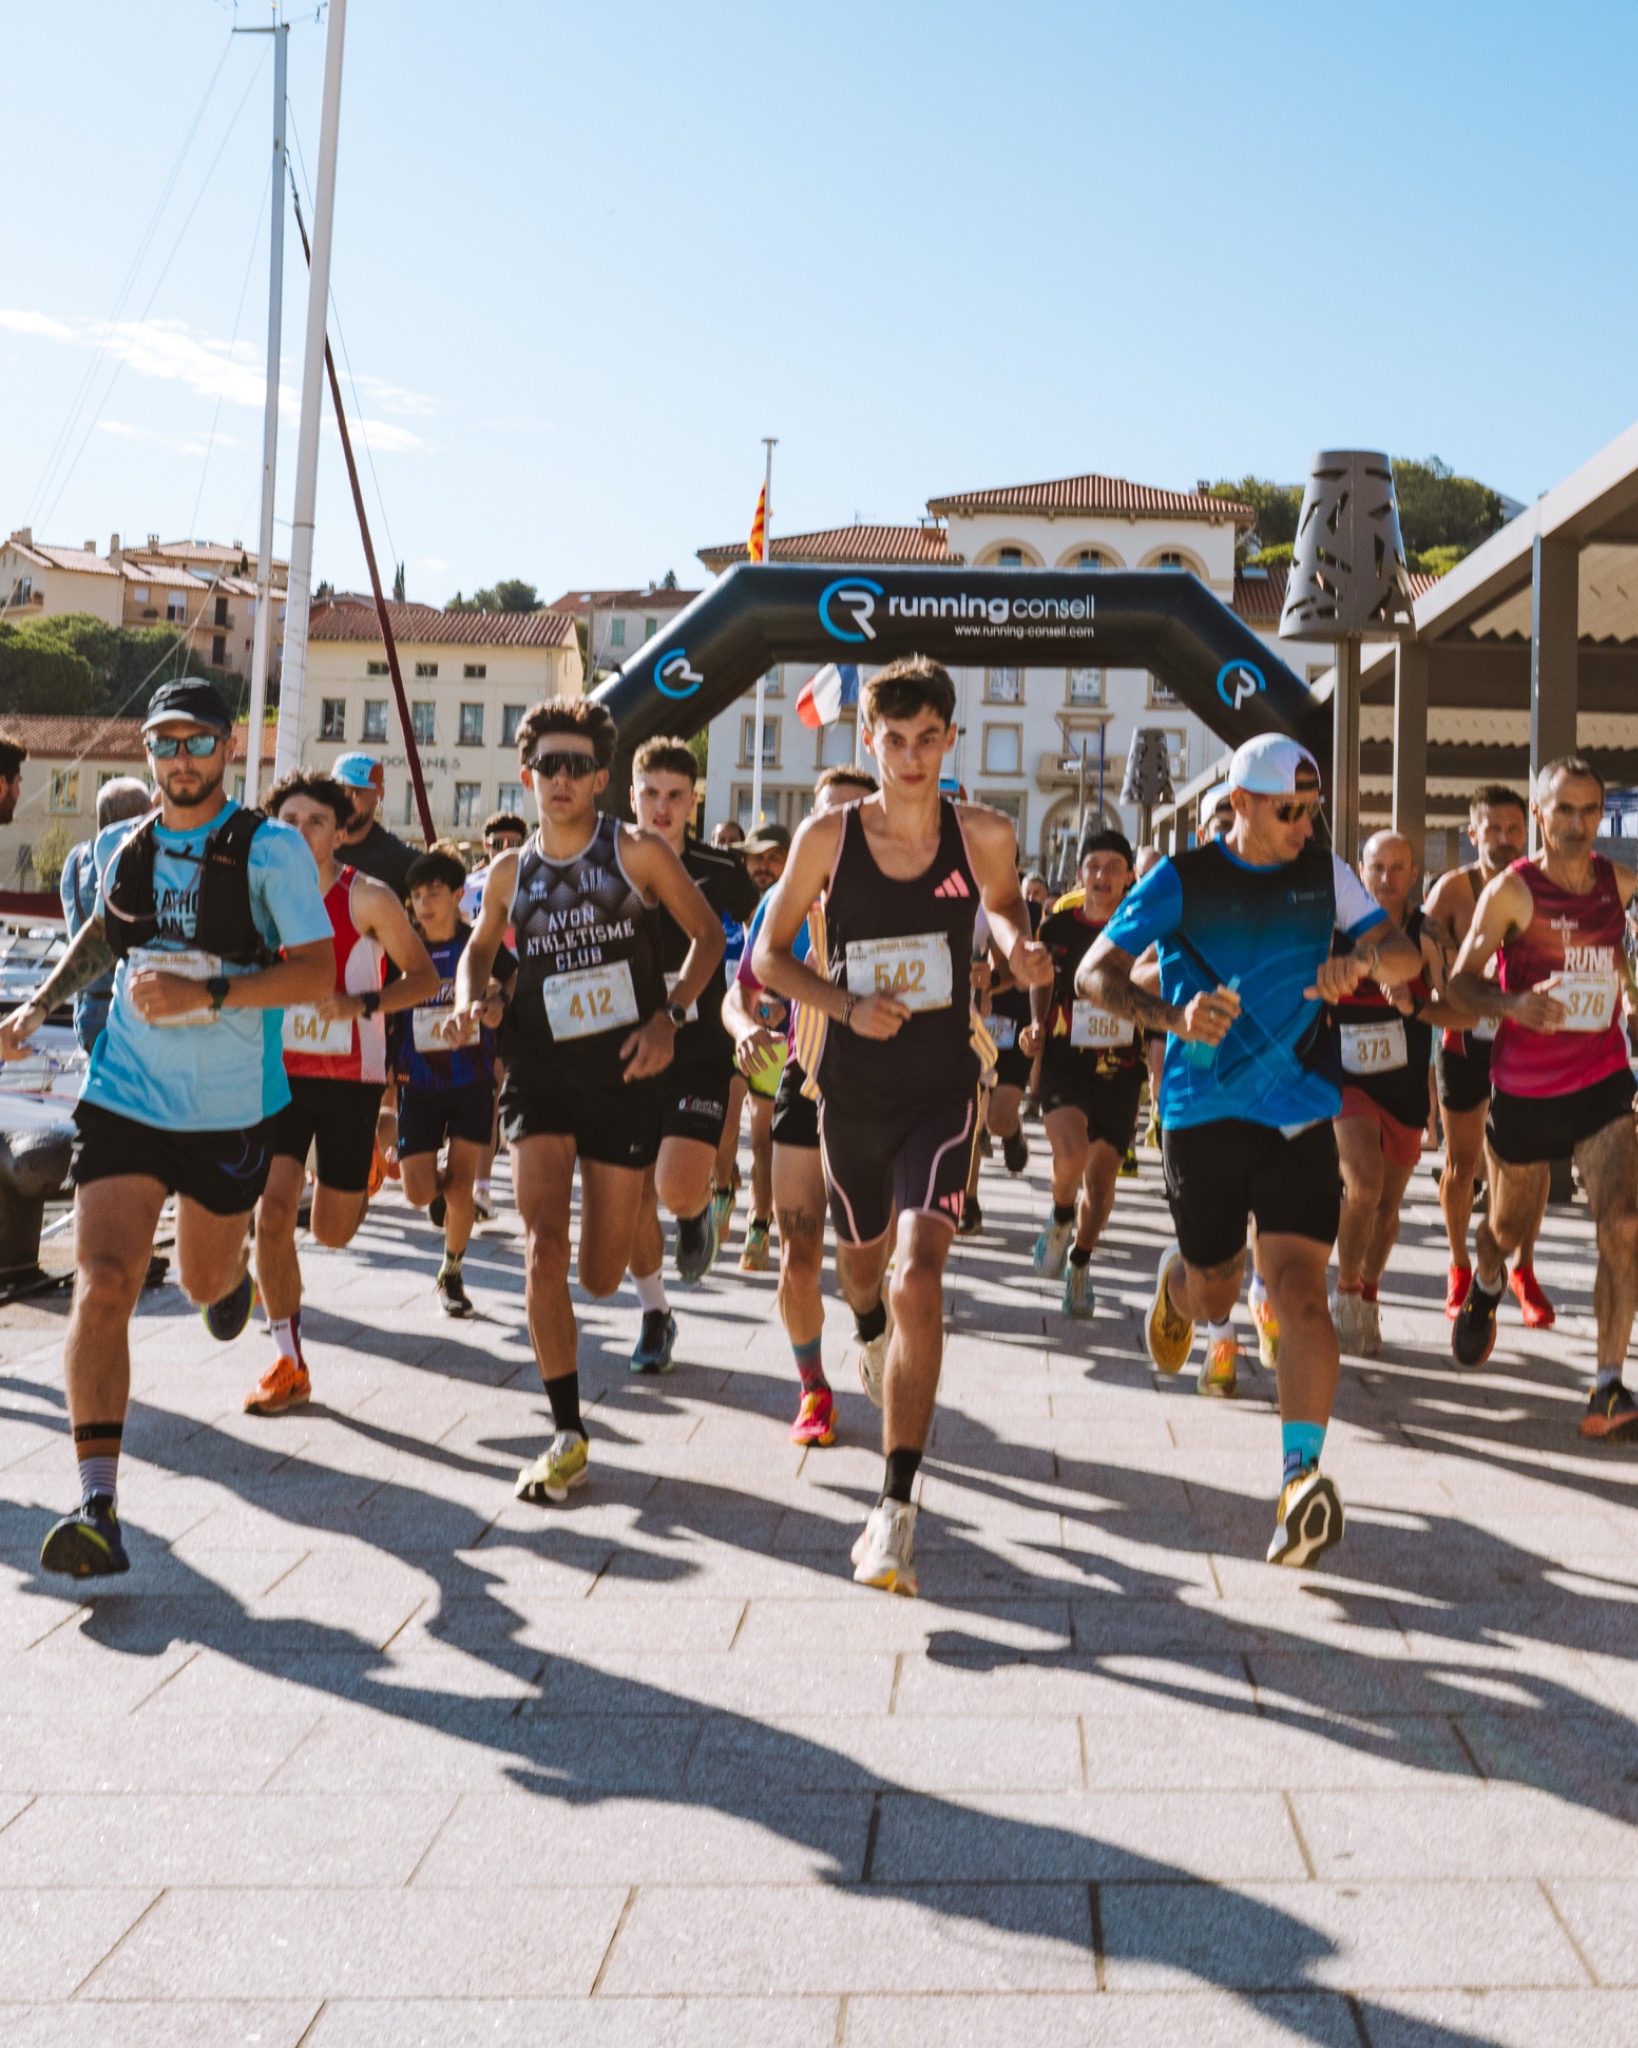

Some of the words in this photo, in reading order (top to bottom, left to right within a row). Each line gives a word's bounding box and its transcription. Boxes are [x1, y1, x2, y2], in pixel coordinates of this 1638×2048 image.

[548, 905, 595, 932] AVON
[527, 918, 634, 956] ATHLETISME
[556, 946, 602, 972] CLUB
[875, 959, 926, 993] 542
[570, 986, 614, 1020] 412
[1357, 1038, 1391, 1063] 373
